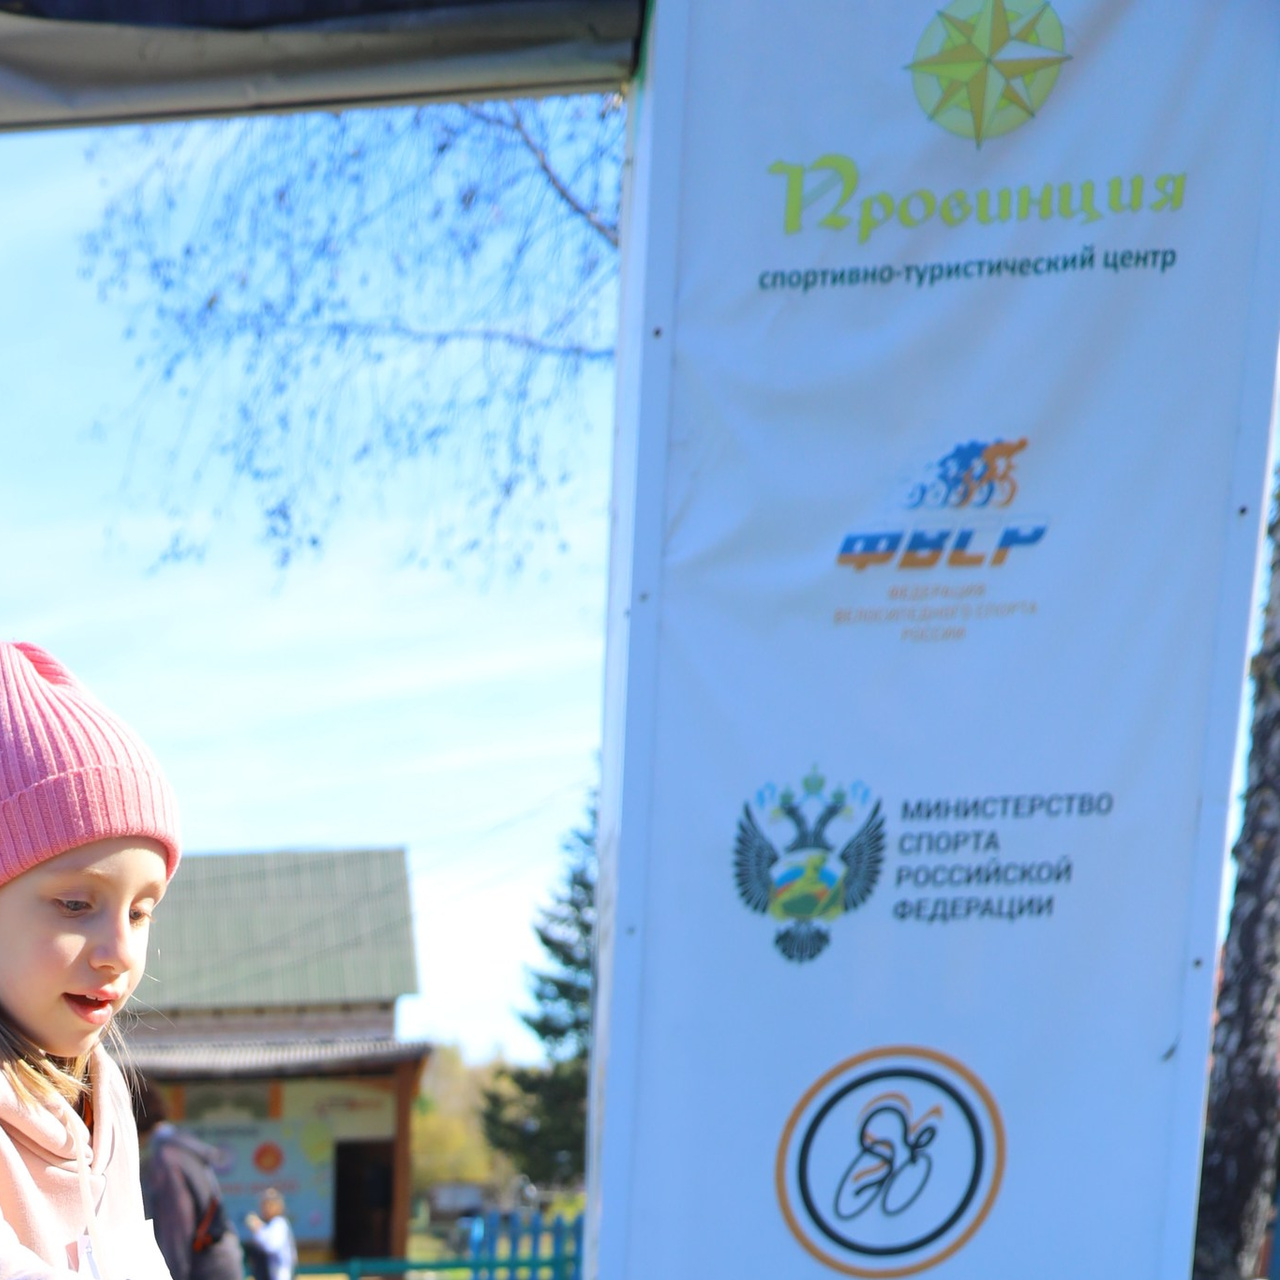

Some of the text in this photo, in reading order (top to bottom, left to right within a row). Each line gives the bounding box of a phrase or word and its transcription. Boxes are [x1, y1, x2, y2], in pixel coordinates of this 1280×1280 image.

[768, 154, 1186, 244] Провинция
[758, 245, 1177, 295] спортивно-туристический центр
[901, 793, 1113, 821] МИНИСТЕРСТВО
[898, 830, 1000, 855] СПОРТА
[894, 854, 1074, 888] РОССИЙСКОЙ
[892, 897, 1054, 923] ФЕДЕРАЦИИ
